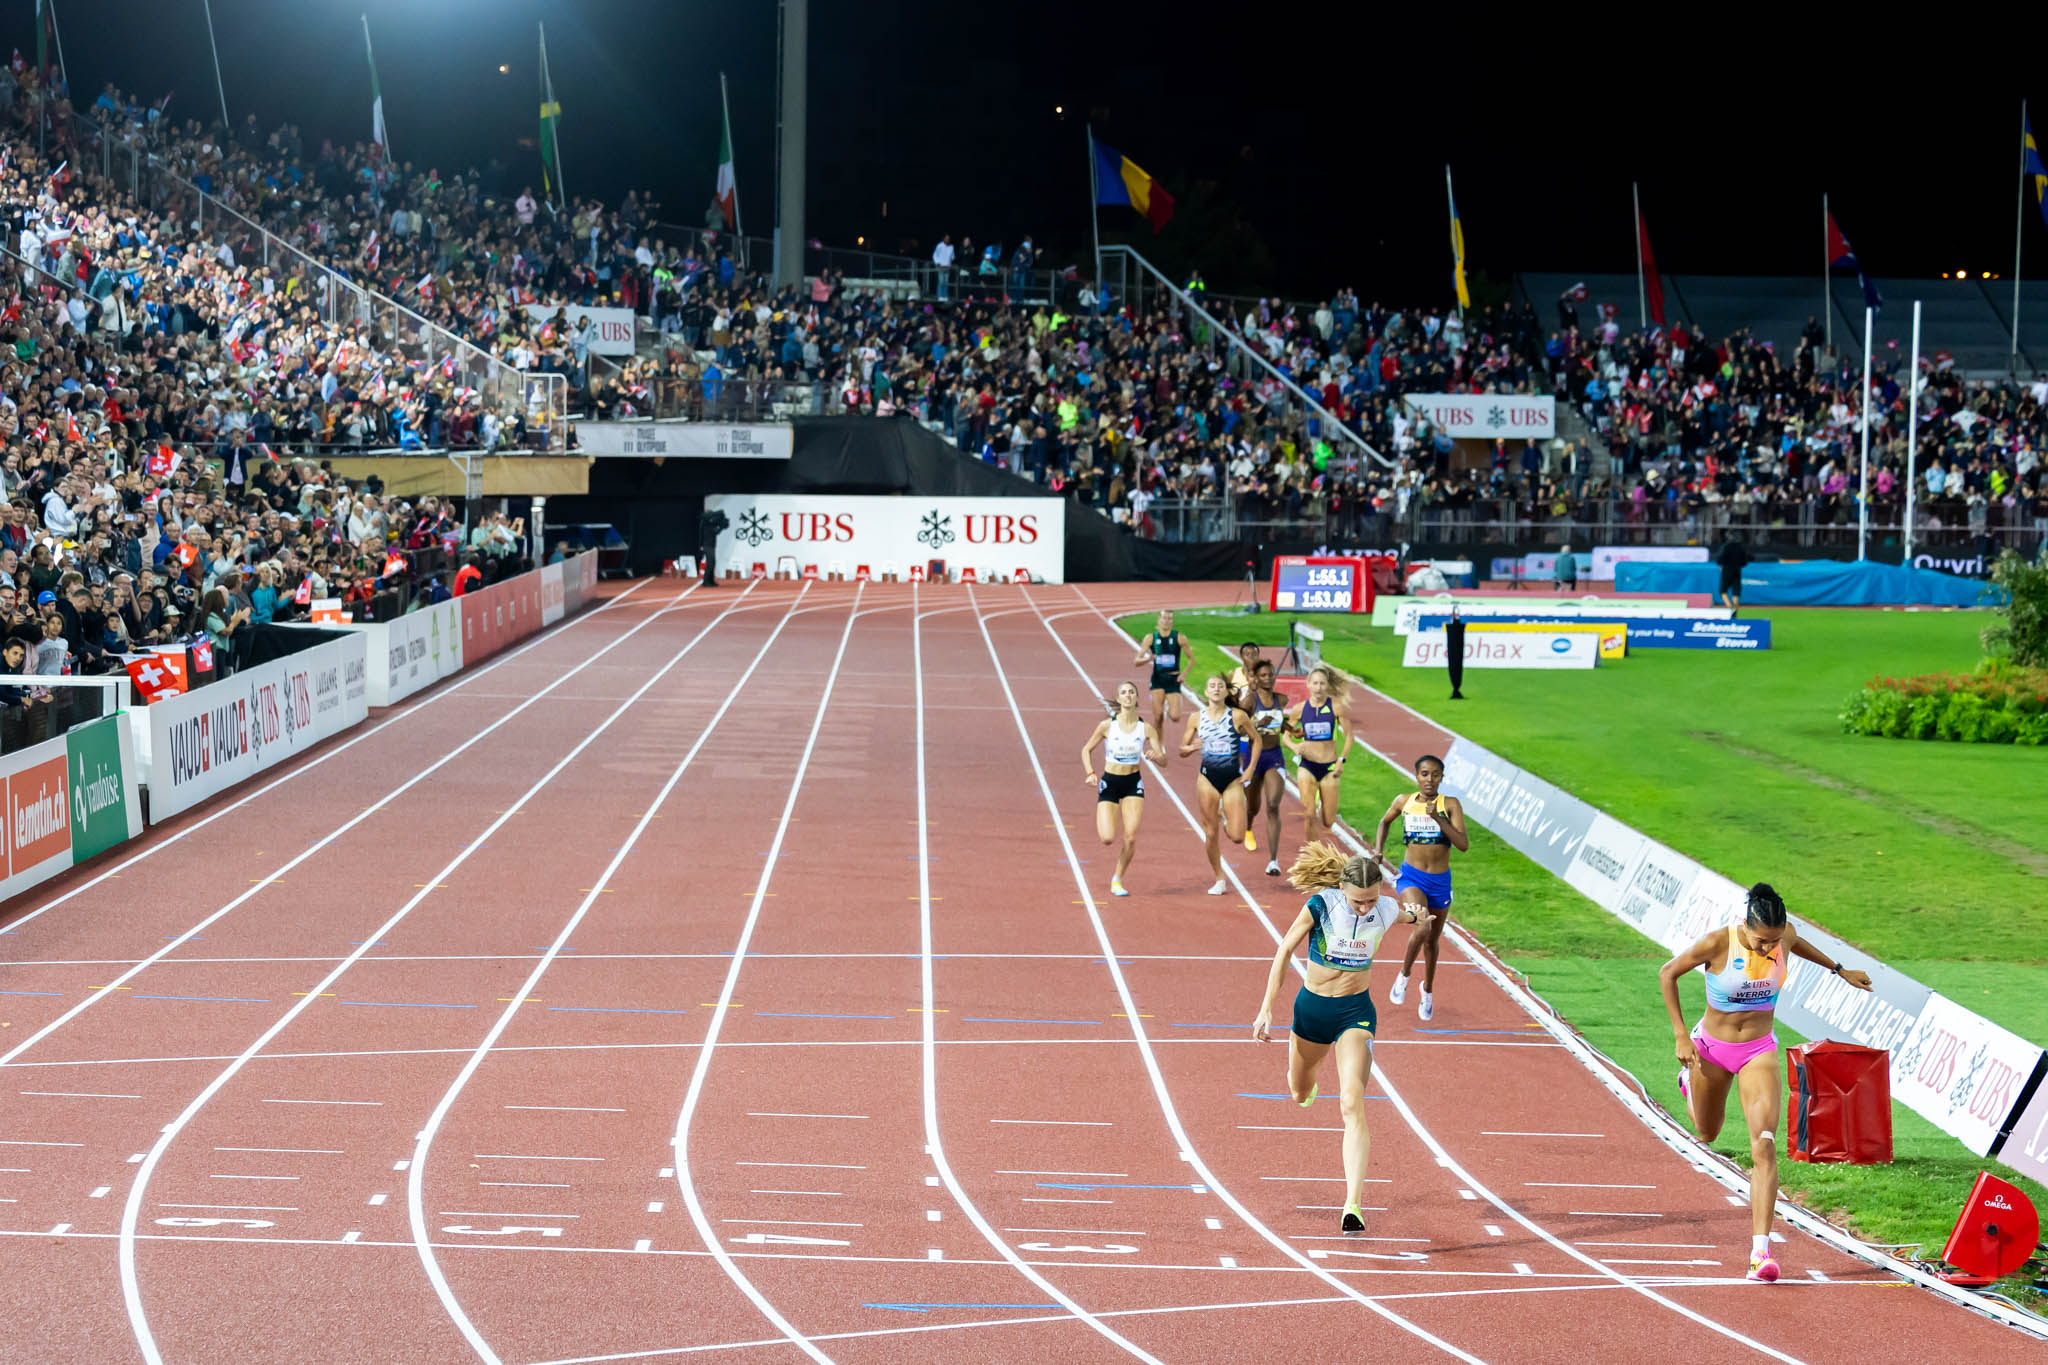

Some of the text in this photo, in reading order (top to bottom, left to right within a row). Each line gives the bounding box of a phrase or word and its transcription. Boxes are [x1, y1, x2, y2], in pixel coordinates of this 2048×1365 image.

[601, 321, 631, 341] UBS
[1435, 408, 1549, 427] UBS UBS
[781, 512, 1039, 544] UBS UBS
[1692, 622, 1751, 634] Schenker
[1416, 636, 1523, 664] grhax
[1716, 637, 1758, 648] Storen
[169, 671, 312, 787] VAUD VAUD UBS UBS
[86, 762, 121, 815] vaudoise
[14, 775, 67, 850] lematin.ch
[1498, 785, 1545, 836] ZEEKR
[1349, 941, 1367, 949] UBS
[1736, 990, 1772, 998] WERRO
[1752, 981, 1770, 989] UBS
[1802, 968, 1870, 1034] DIAMOND
[1850, 995, 1917, 1061] LEAGUE
[1917, 1028, 2023, 1128] UBS UBS
[1983, 1200, 2013, 1211] OMEGA
